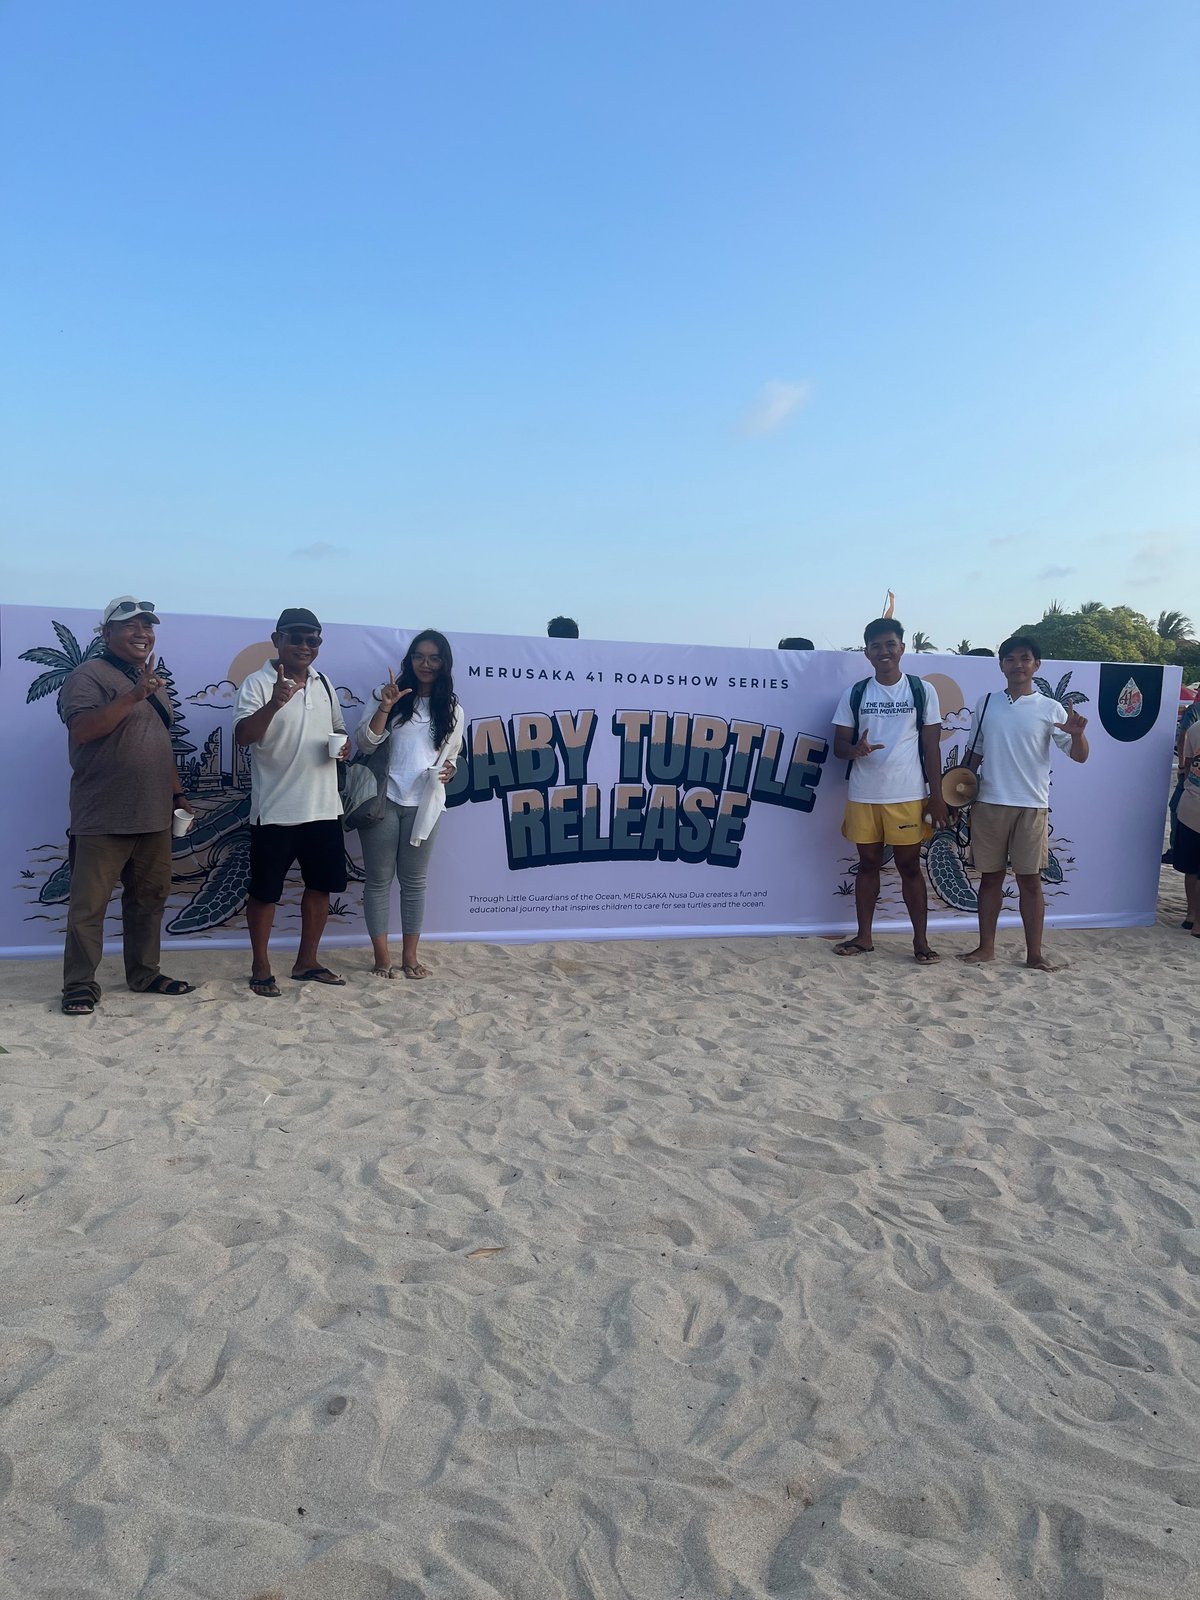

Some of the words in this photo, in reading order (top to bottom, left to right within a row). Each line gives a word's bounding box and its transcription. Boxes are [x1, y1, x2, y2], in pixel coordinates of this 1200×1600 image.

[468, 665, 575, 682] MERUSAKA
[585, 671, 603, 683] 41
[614, 672, 718, 687] ROADSHOW
[728, 677, 789, 690] SERIES
[878, 701, 895, 709] NUSA
[879, 707, 914, 715] MOVEMENT
[612, 709, 829, 813] TURTLE
[503, 783, 751, 870] RELEASE
[469, 894, 504, 904] Through
[506, 894, 527, 902] Little
[528, 894, 569, 902] Guardians
[570, 893, 579, 901] of
[580, 893, 593, 901] the
[595, 893, 622, 901] Ocean,
[623, 892, 667, 900] MERUSAKA
[689, 891, 704, 899] Dua
[739, 890, 752, 898] fun
[469, 905, 518, 914] educational
[519, 904, 550, 914] journey
[551, 904, 568, 912] that
[569, 904, 600, 913] inspires
[601, 903, 633, 911] children
[687, 901, 711, 909] turtles
